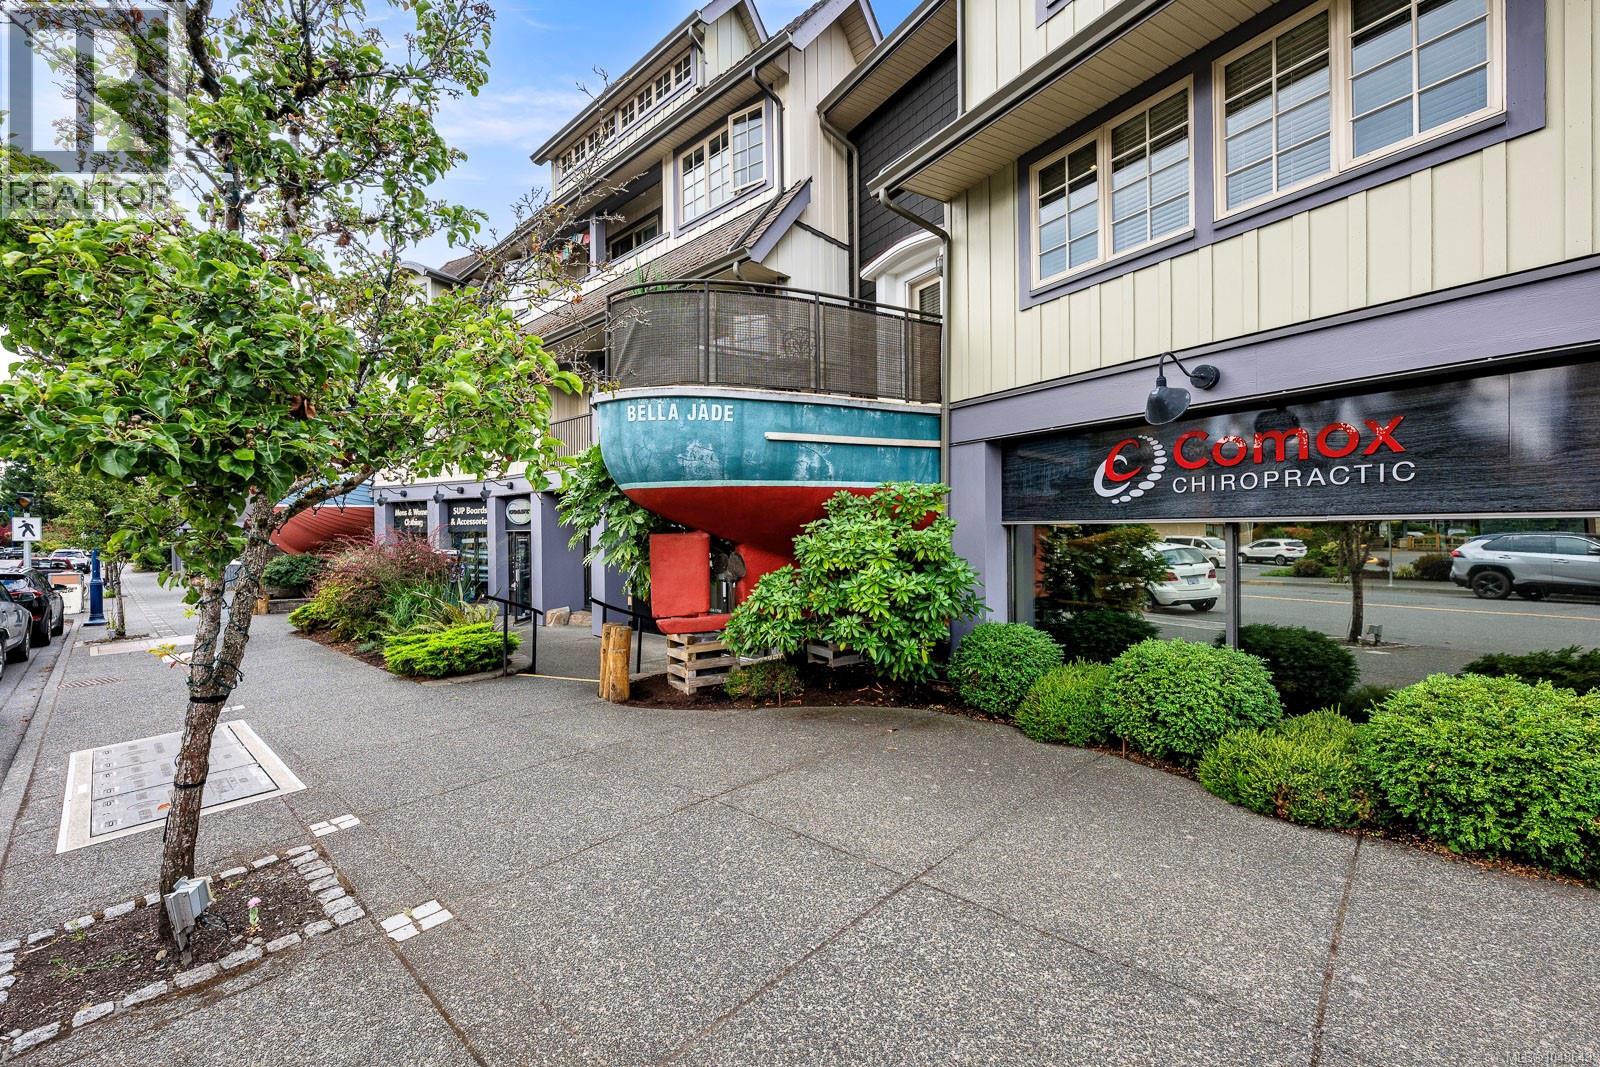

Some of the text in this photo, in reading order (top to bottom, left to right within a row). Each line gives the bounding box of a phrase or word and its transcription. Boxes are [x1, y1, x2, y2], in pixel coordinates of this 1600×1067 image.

[627, 403, 734, 422] BELLA JADE
[1172, 416, 1407, 470] Comox
[1172, 461, 1416, 493] CHIROPRACTIC
[453, 505, 488, 515] SUP Boards
[450, 518, 456, 526] &
